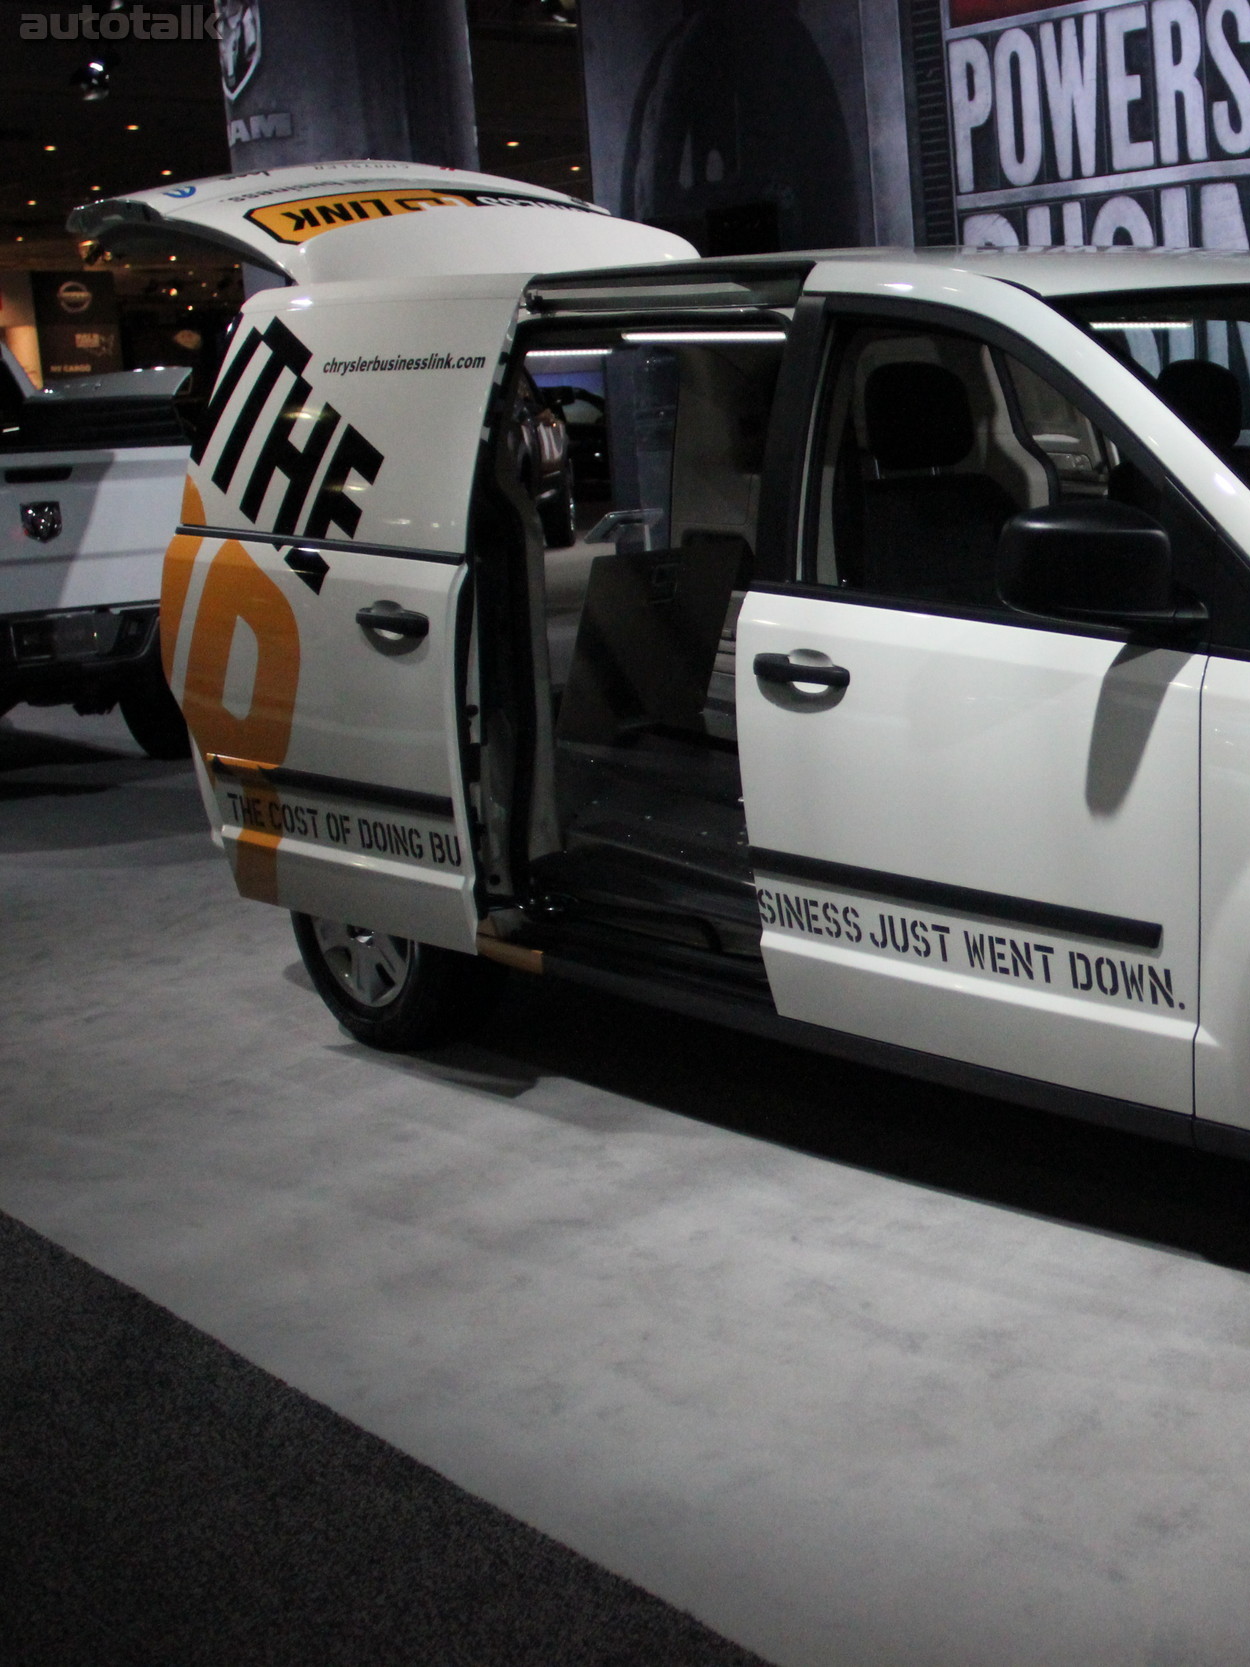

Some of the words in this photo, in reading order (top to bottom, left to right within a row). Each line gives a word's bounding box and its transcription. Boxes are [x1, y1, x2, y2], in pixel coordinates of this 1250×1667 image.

[229, 113, 293, 147] AM
[281, 199, 393, 232] LINK
[323, 353, 486, 376] chryslerbusinesslink.com
[227, 792, 266, 828] THE
[270, 800, 319, 839] COST
[326, 811, 351, 845] OF
[357, 817, 424, 860] DOING
[429, 831, 462, 867] BU
[757, 888, 863, 943] SINESS
[869, 913, 950, 962] JUST
[963, 930, 1055, 984] WENT
[1068, 951, 1187, 1010] DOWN.
